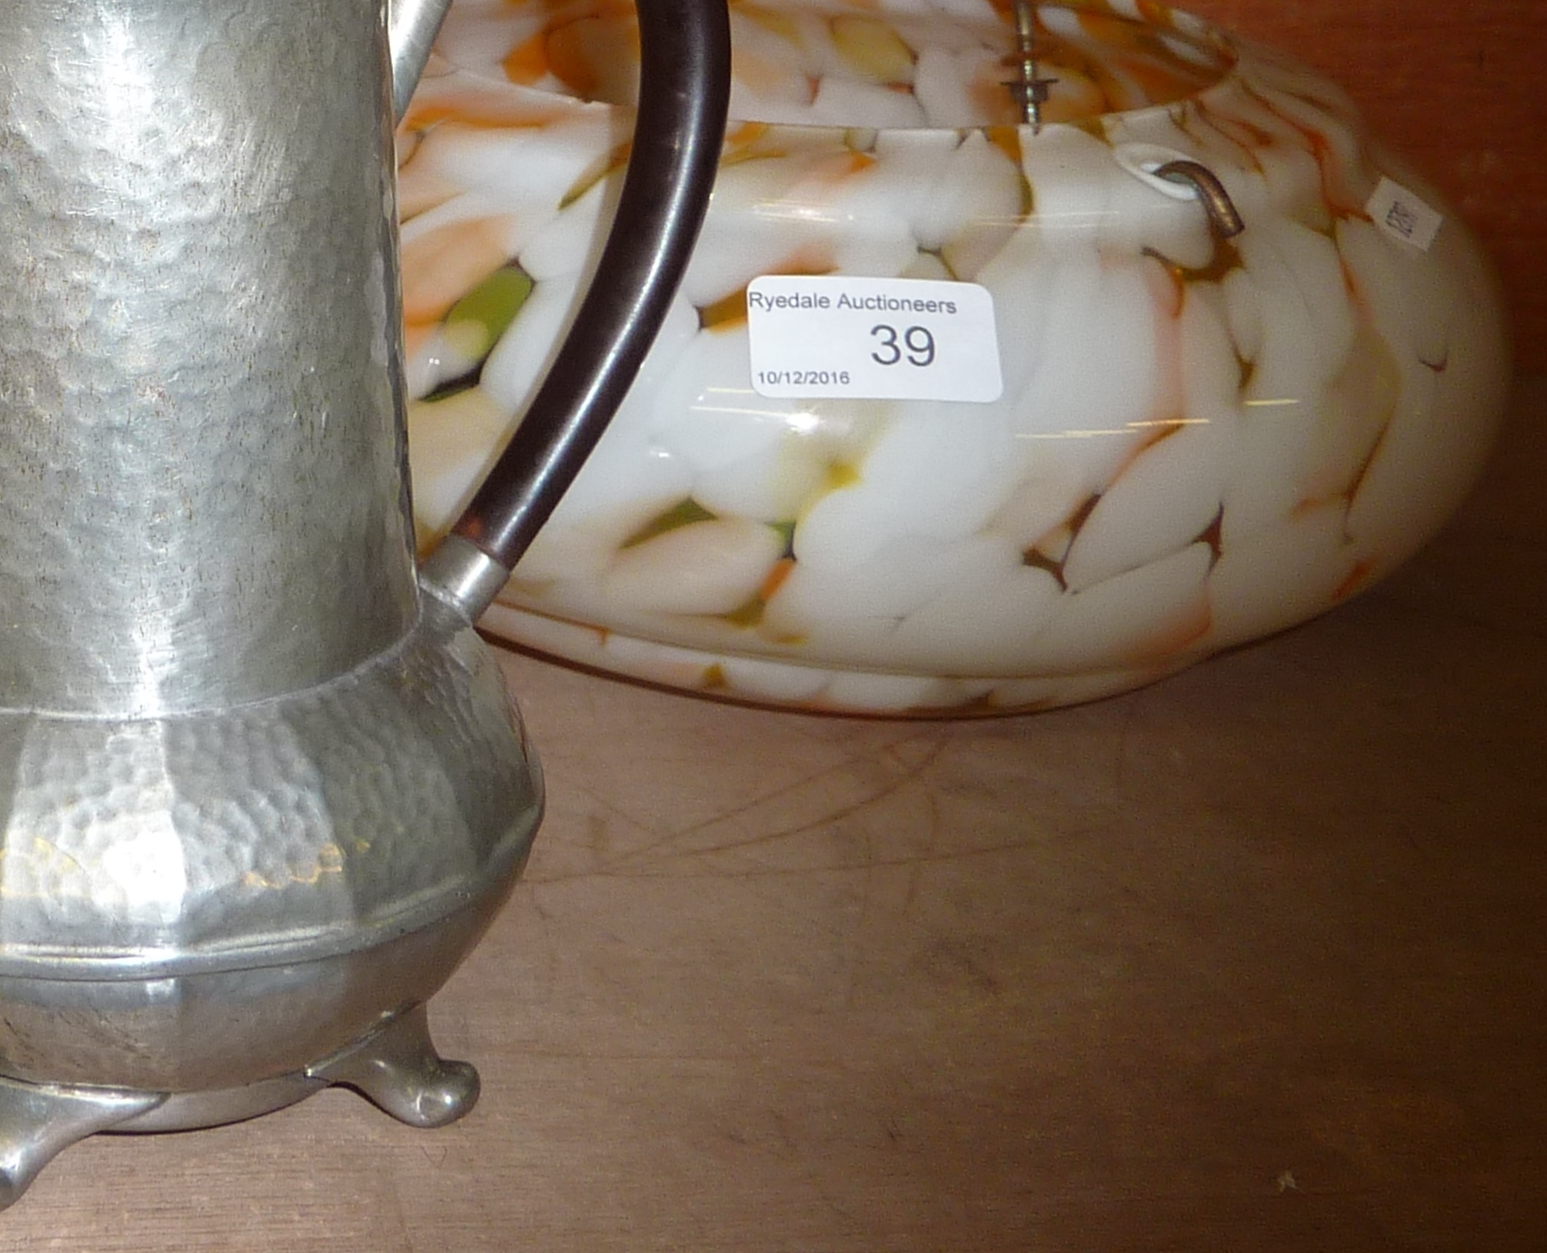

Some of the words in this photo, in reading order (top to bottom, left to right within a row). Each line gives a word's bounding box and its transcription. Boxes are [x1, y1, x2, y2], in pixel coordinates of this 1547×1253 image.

[749, 291, 831, 312] Ryedale
[837, 293, 958, 314] Auctioneers
[870, 324, 936, 367] 39
[757, 370, 851, 385] 10/12/2016
